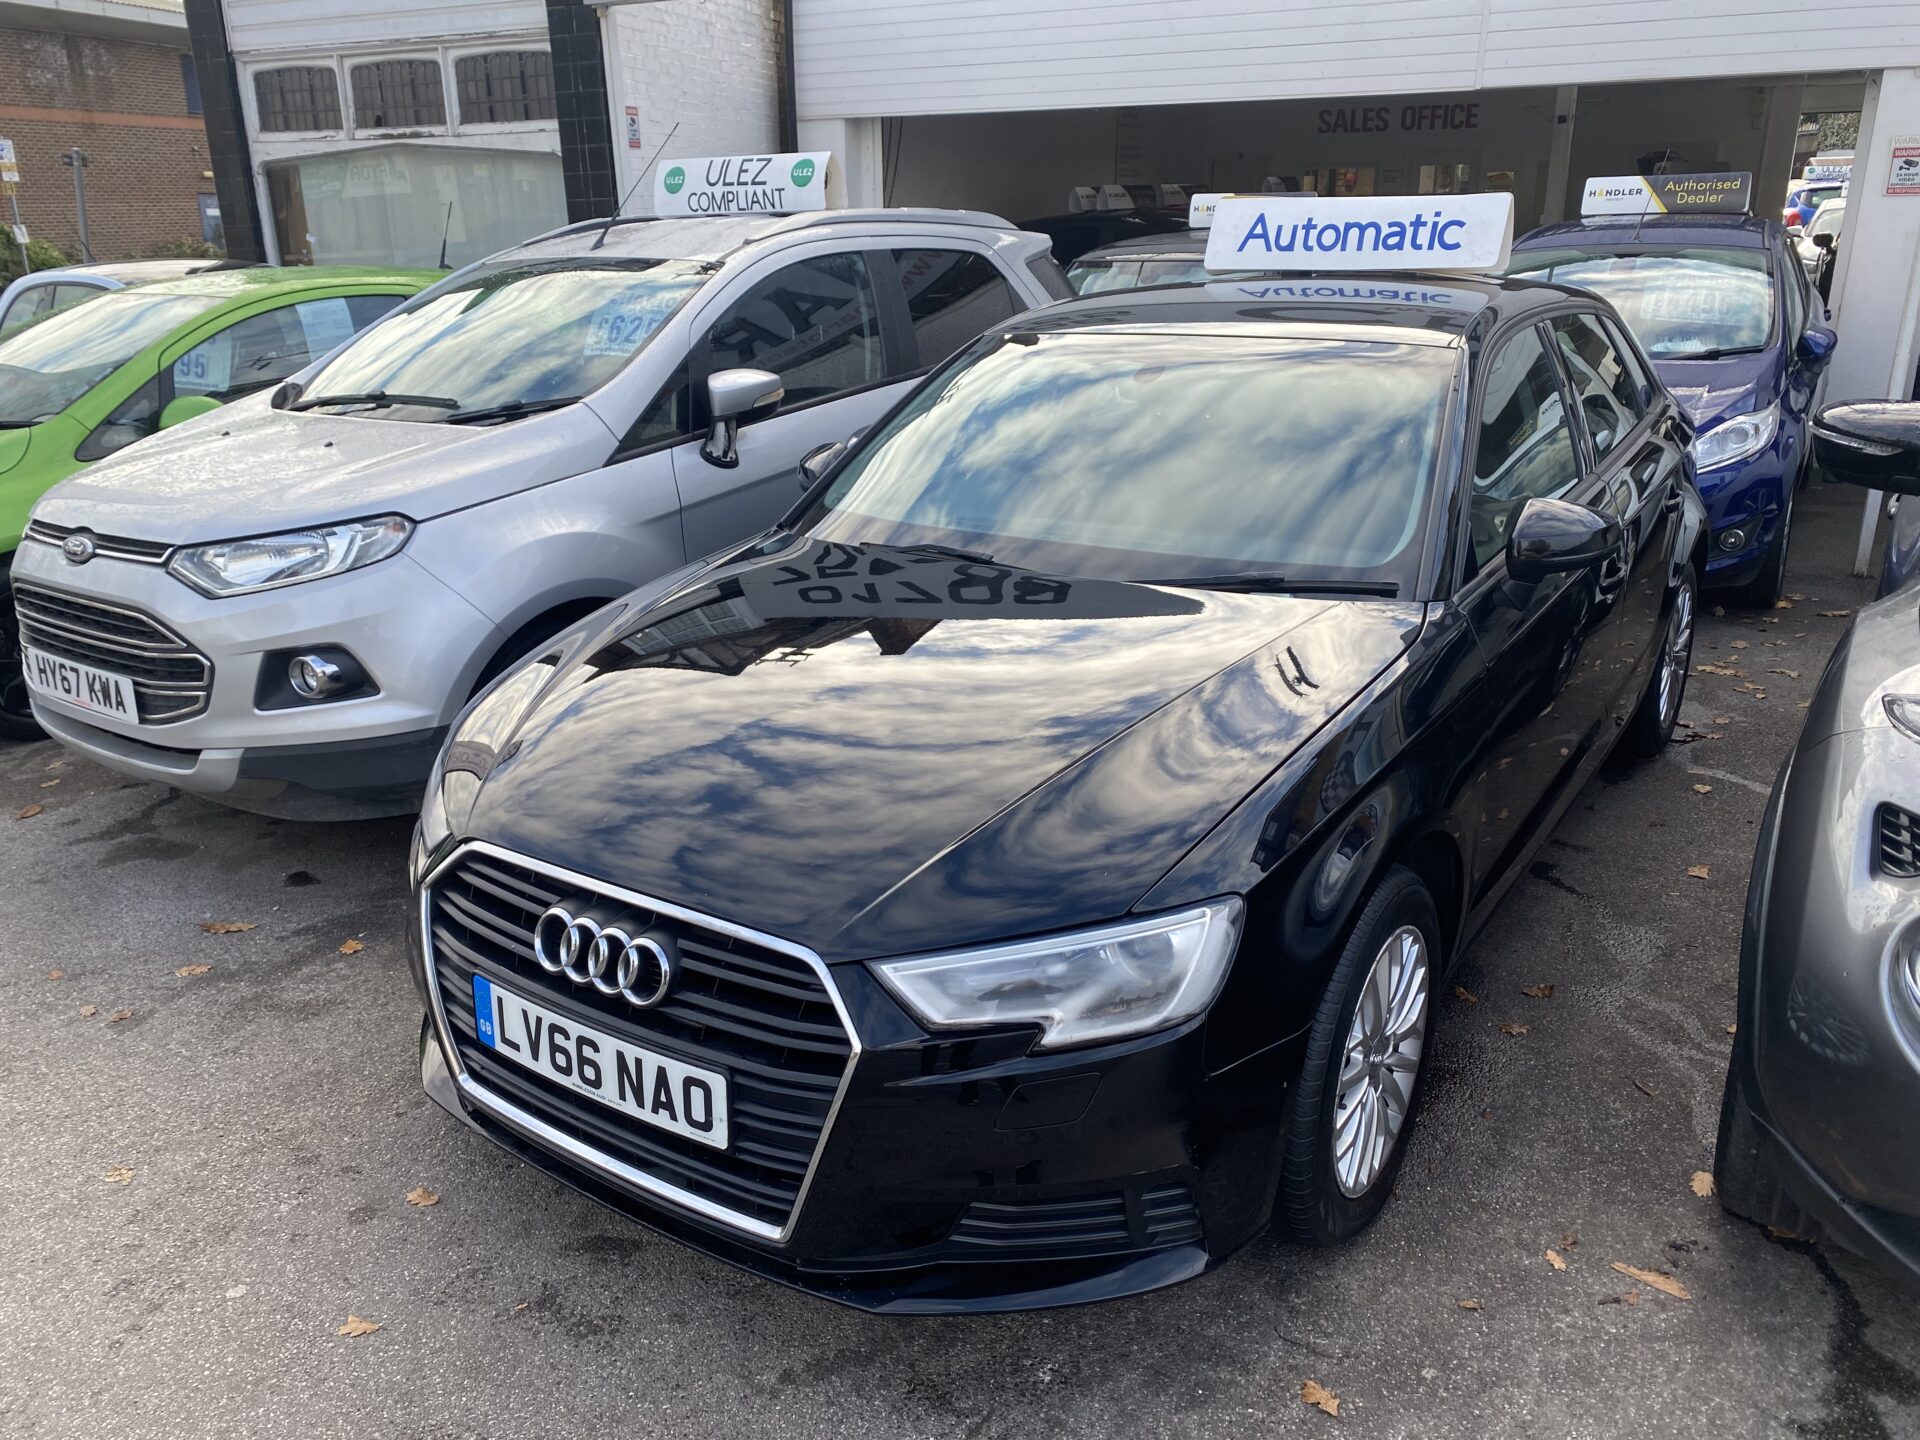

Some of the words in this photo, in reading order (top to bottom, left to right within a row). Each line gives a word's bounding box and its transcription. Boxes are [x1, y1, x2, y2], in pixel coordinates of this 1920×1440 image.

[1317, 107, 1391, 134] SALES
[1400, 103, 1480, 131] OFFICE
[665, 175, 683, 184] ULEZ
[706, 157, 773, 187] ULEZ
[793, 167, 813, 177] ULEZ
[1589, 188, 1643, 198] HANDLER
[1665, 177, 1742, 192] Authorised
[687, 188, 786, 213] COMPLIANT
[1676, 192, 1725, 204] Dealer
[1237, 211, 1467, 253] Automatic
[35, 654, 80, 698] HY67
[85, 671, 127, 714] KWA
[479, 1018, 492, 1035] GB
[496, 995, 603, 1090] LV66
[616, 1049, 714, 1133] NAO
